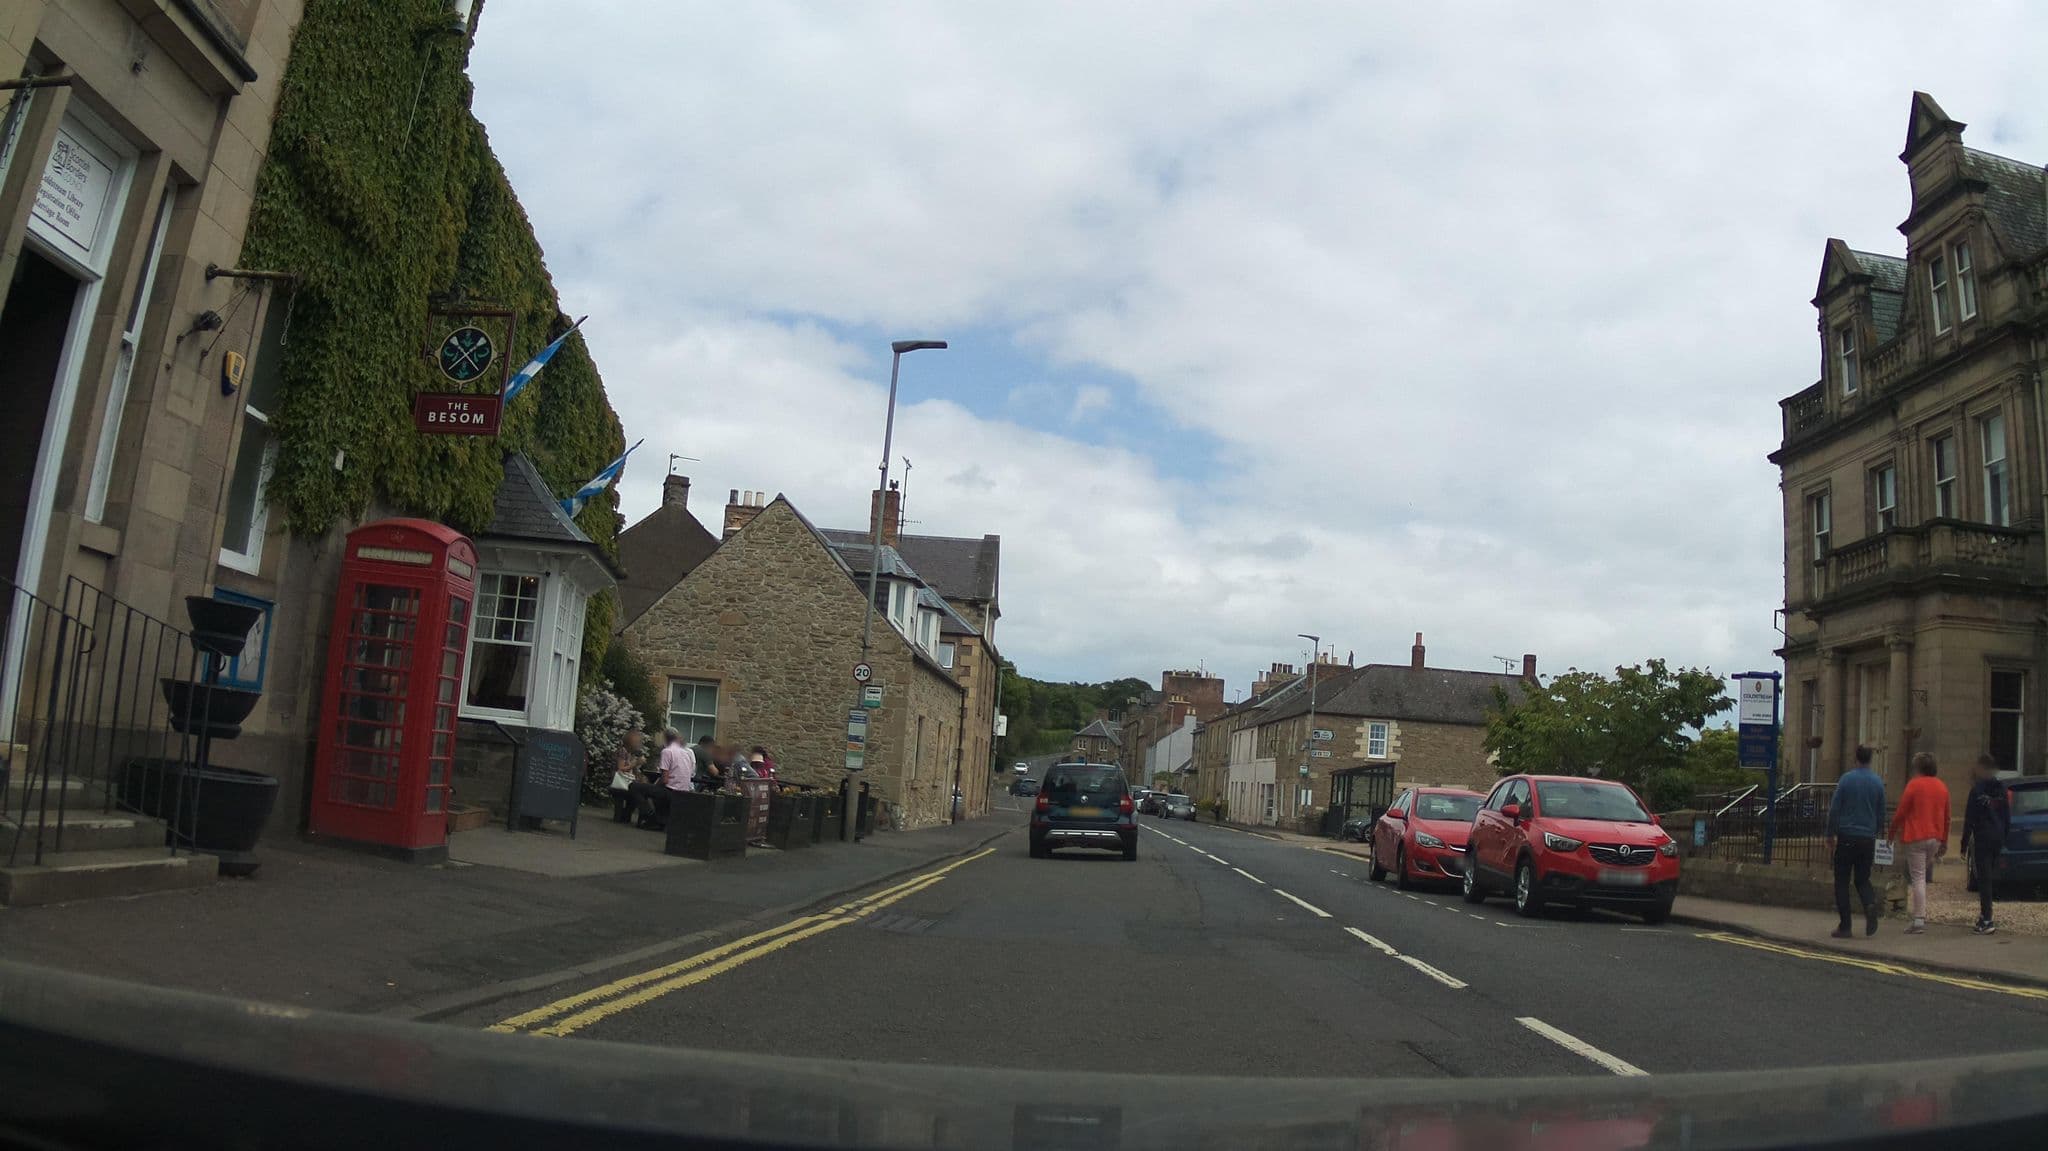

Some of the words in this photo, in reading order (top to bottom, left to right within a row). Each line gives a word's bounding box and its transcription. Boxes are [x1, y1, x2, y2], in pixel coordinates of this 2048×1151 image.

[65, 161, 87, 183] Borders
[42, 175, 67, 196] oldstream
[67, 190, 84, 209] Library
[448, 402, 469, 411] THE
[428, 411, 484, 424] BESOM
[855, 668, 869, 678] 20
